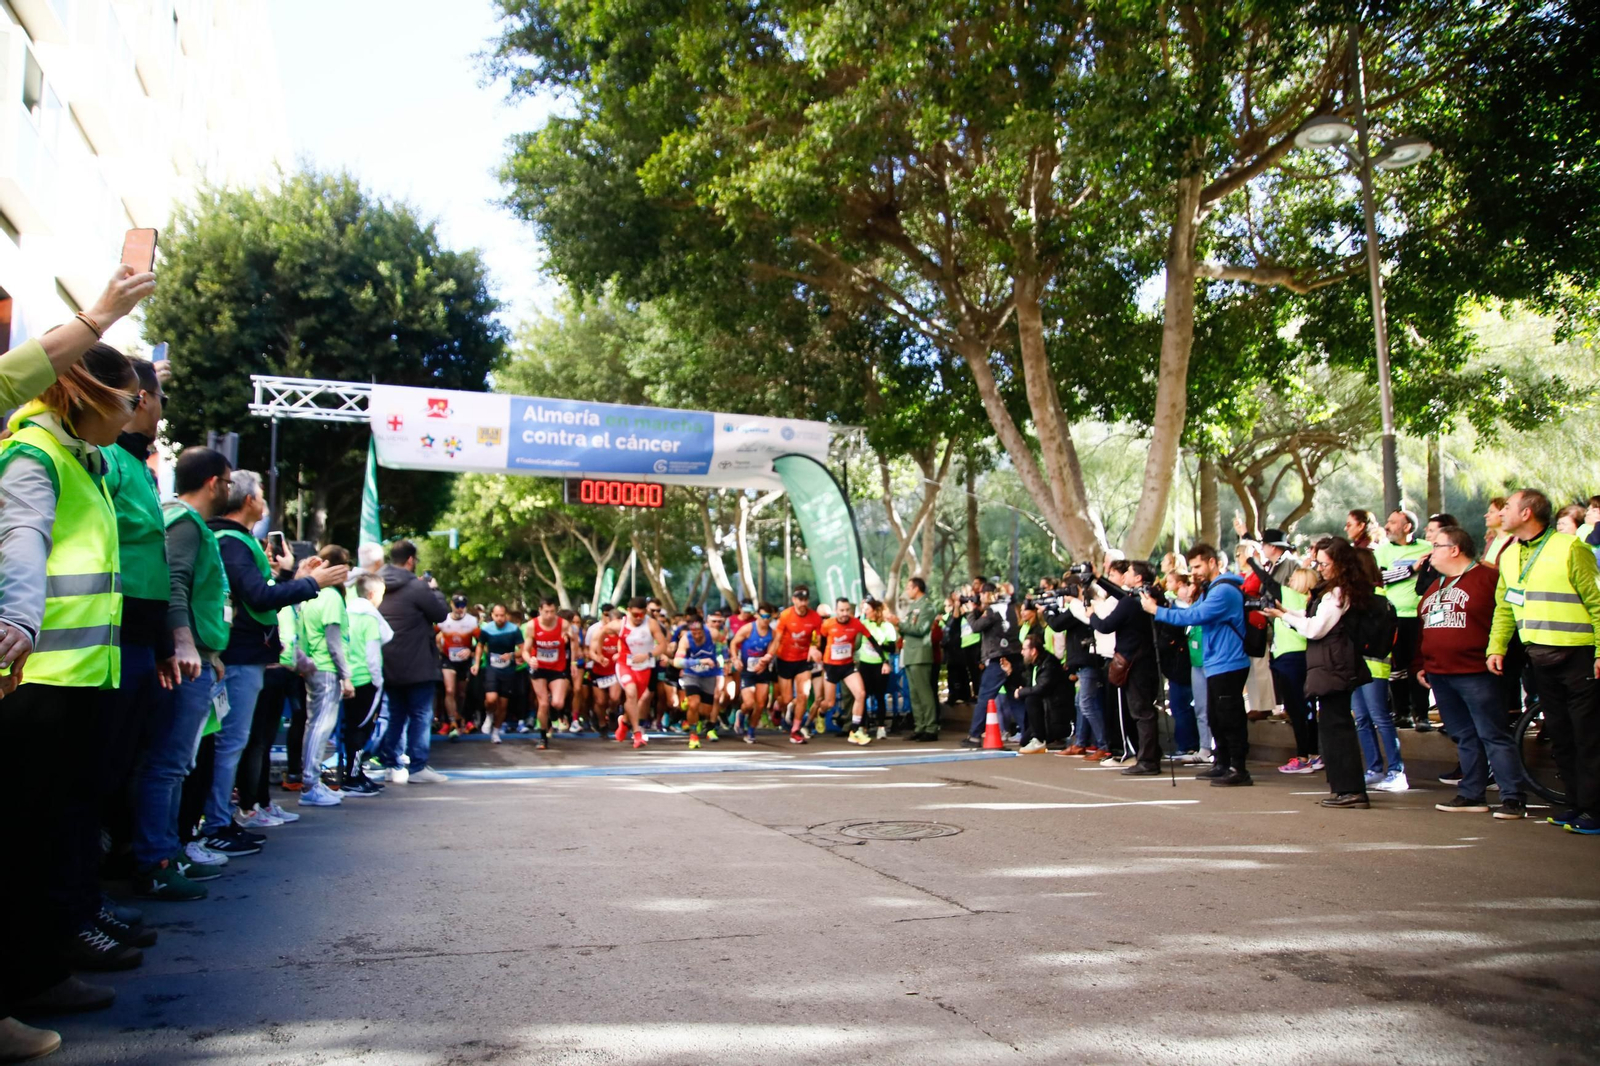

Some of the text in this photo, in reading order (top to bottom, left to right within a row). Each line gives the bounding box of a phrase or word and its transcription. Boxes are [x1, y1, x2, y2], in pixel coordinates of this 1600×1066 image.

[523, 405, 704, 434] Almería en marcha
[522, 430, 681, 453] contra el cáncer
